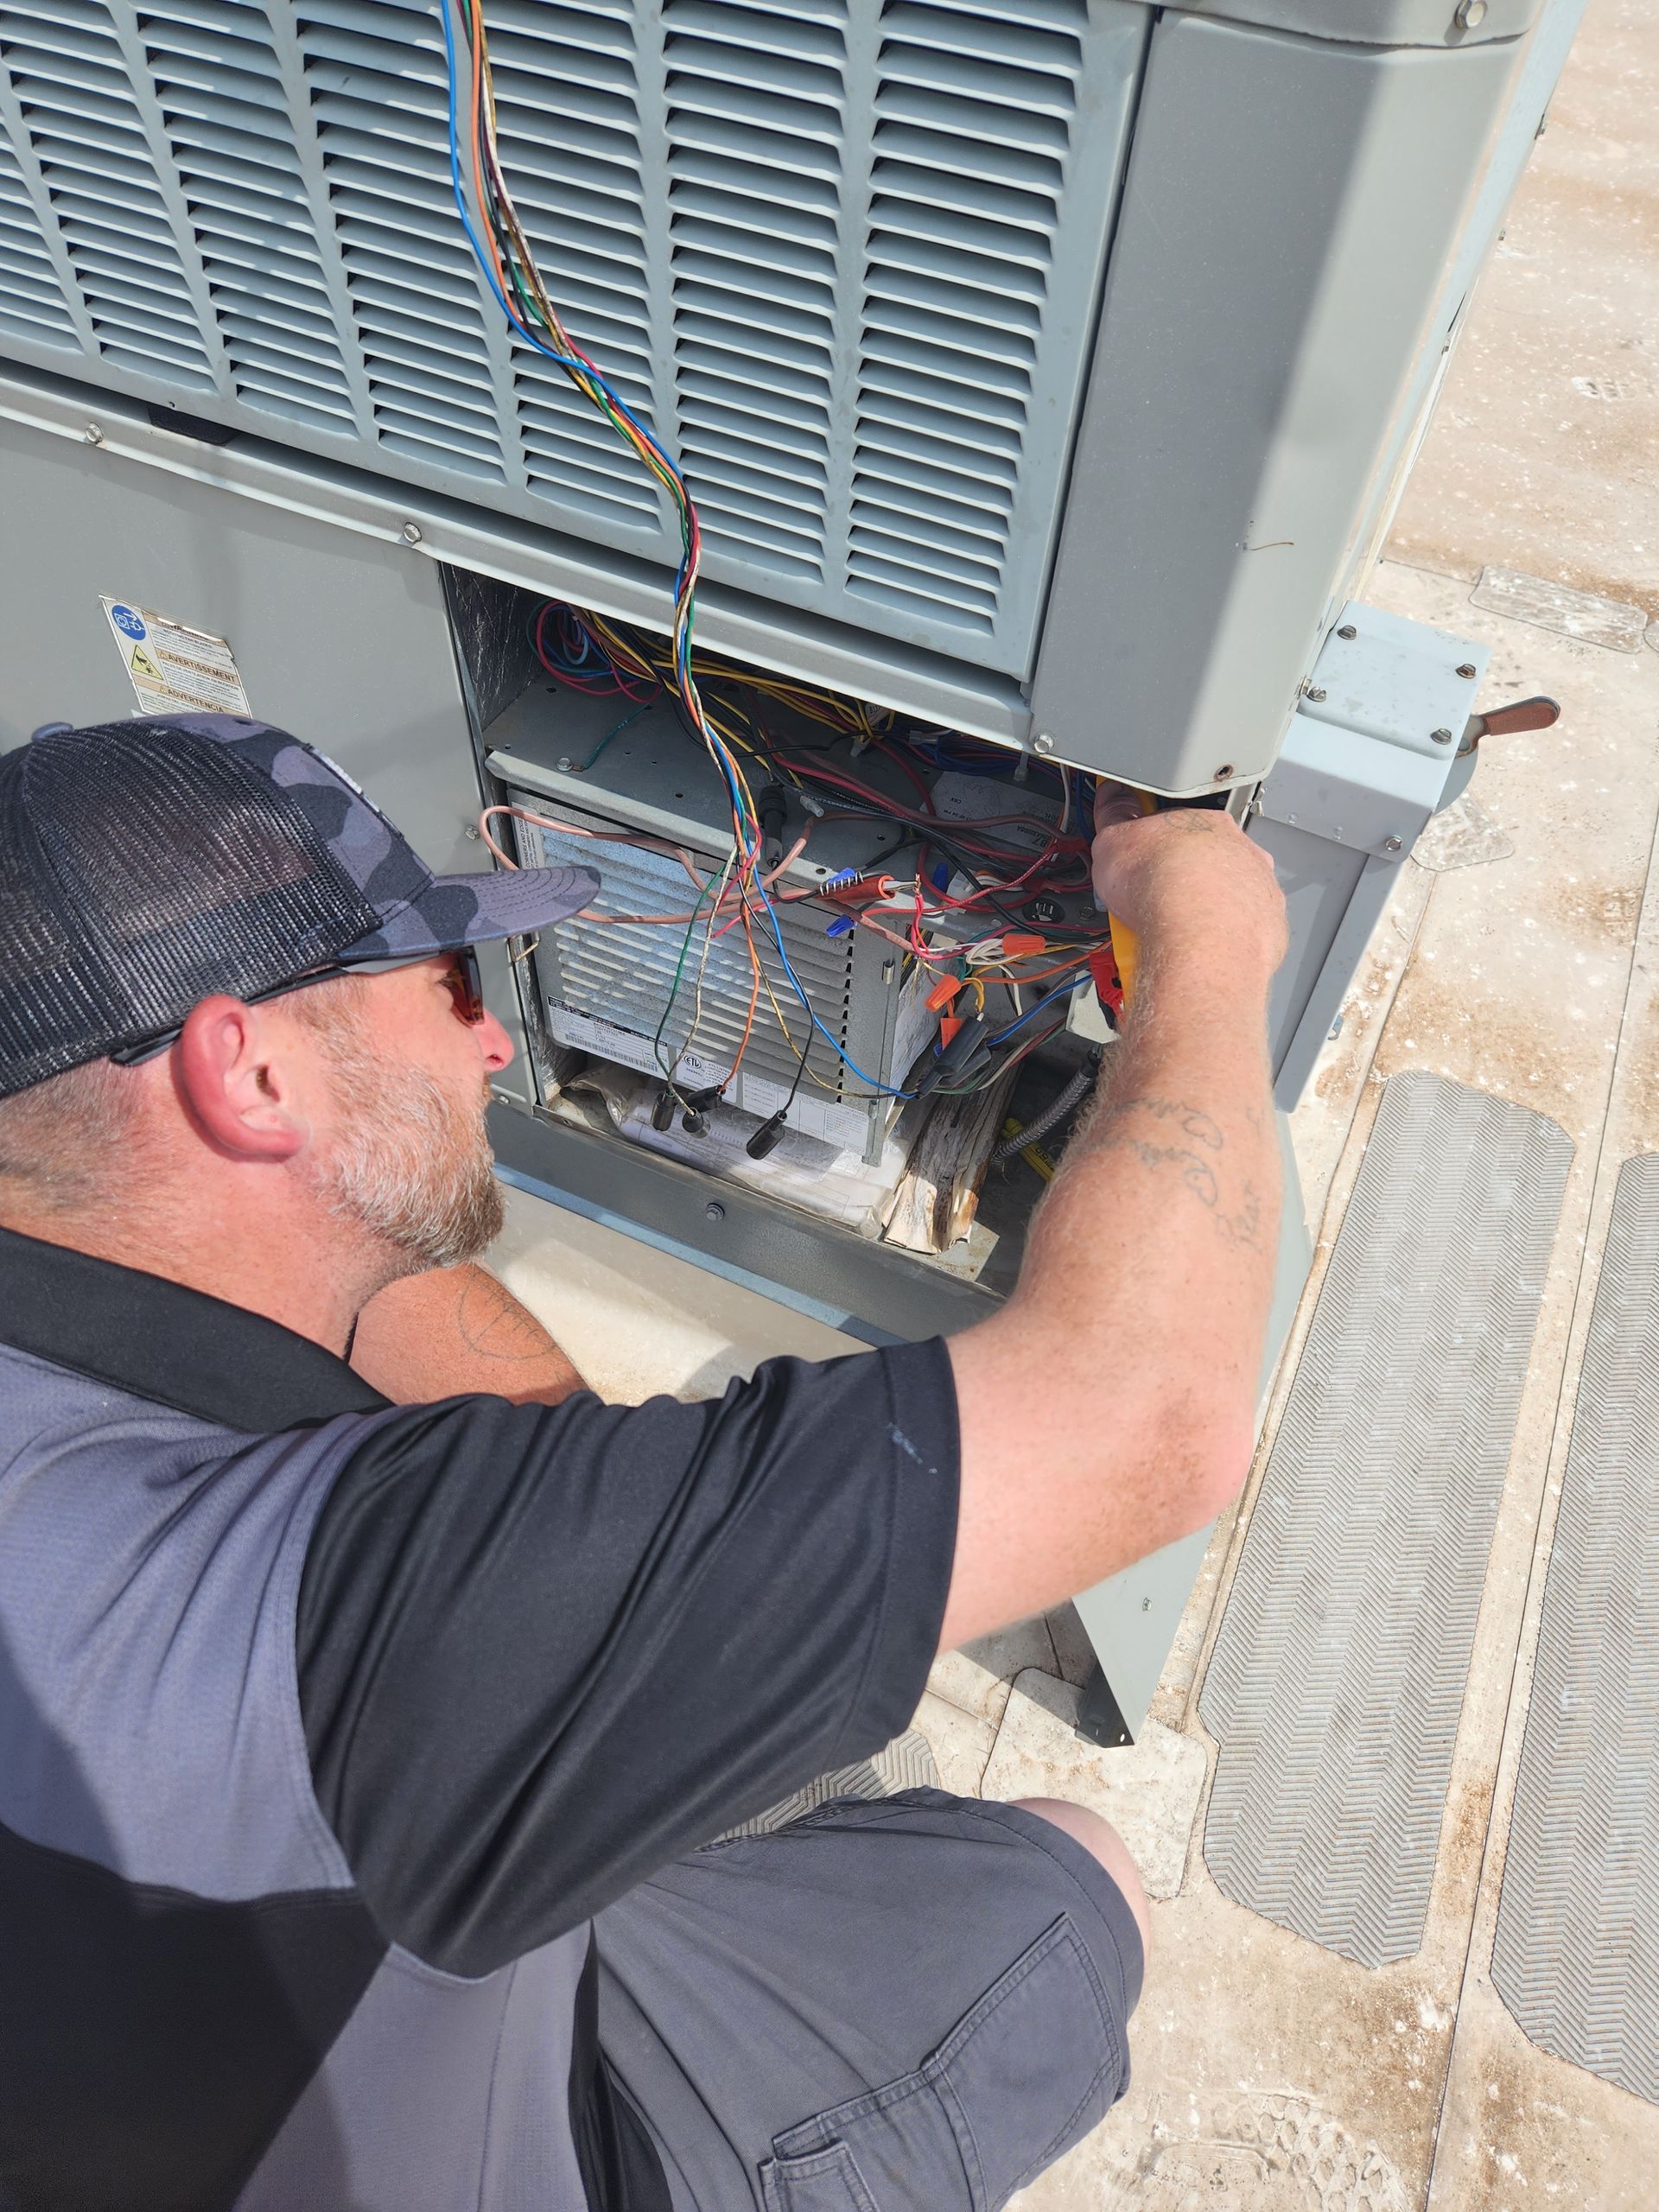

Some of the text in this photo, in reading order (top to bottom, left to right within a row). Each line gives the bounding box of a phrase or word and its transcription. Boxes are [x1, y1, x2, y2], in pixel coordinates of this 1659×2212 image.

[168, 654, 235, 683] AVERTISSEMENT
[168, 689, 224, 713] ADVERTENCIA
[686, 1057, 700, 1067] ETL
